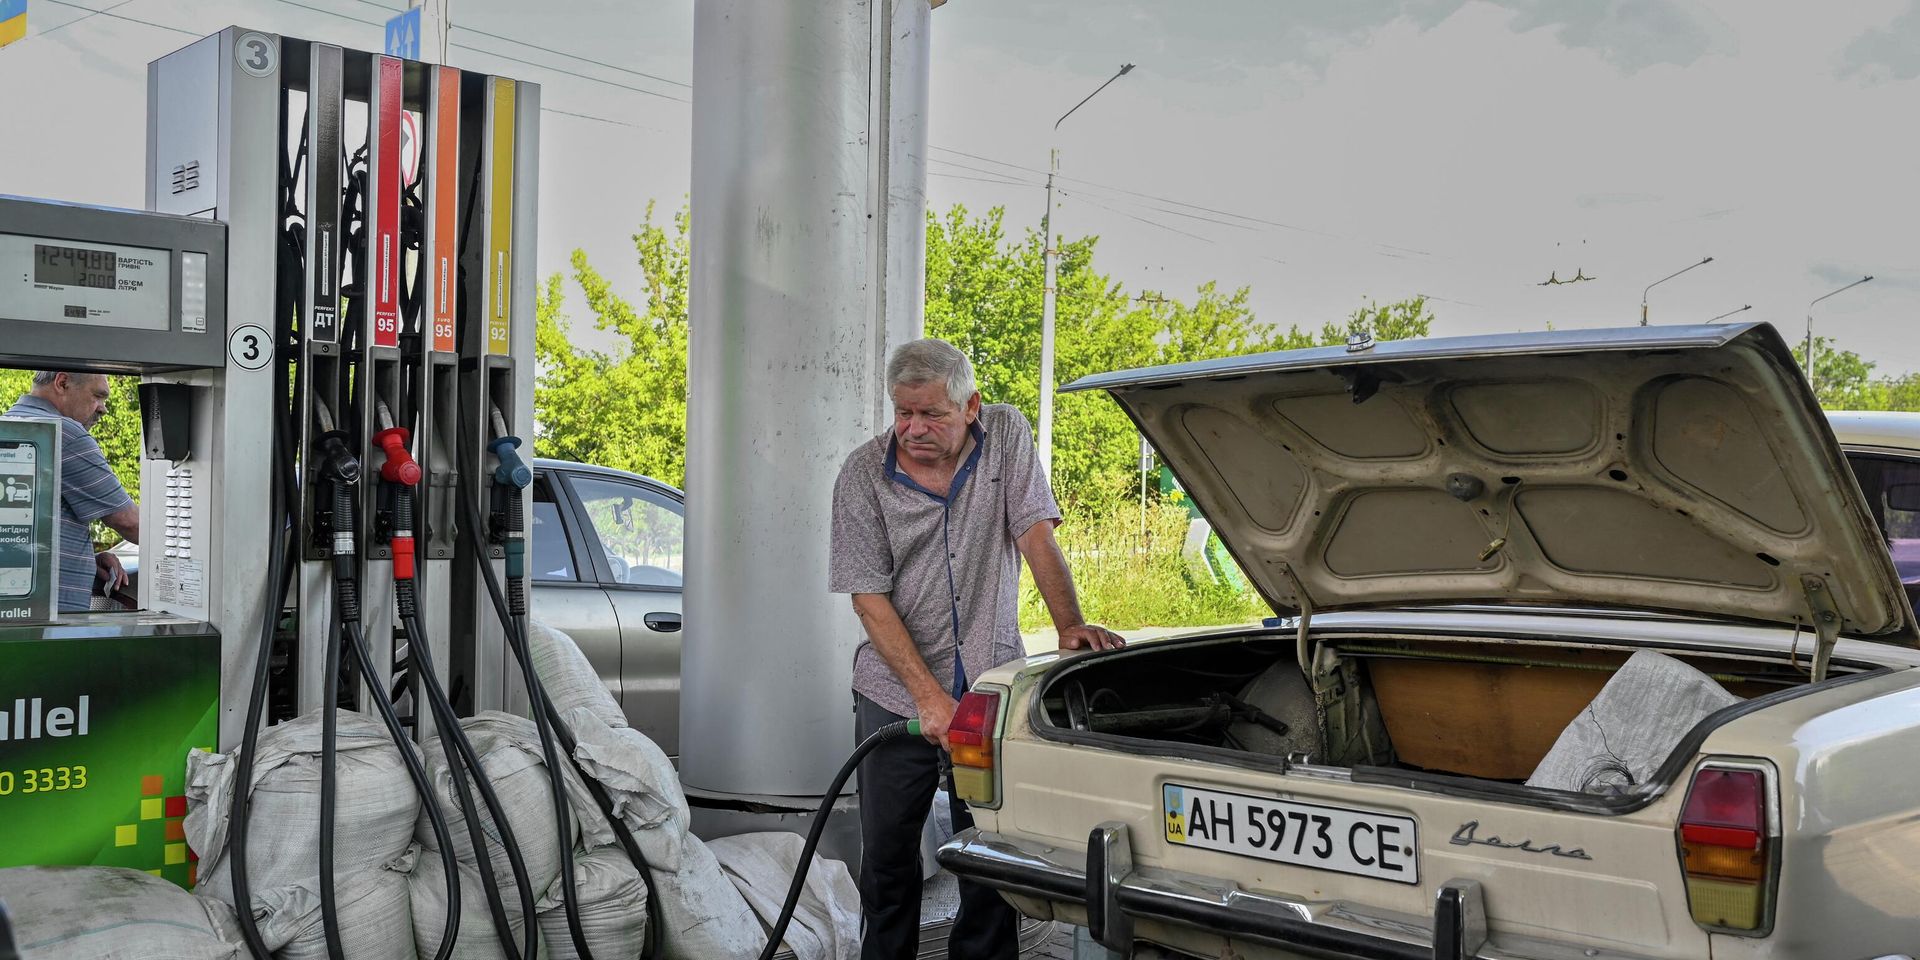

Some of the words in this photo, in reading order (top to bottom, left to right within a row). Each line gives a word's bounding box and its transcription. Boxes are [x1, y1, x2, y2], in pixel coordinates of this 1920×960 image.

[246, 40, 269, 69] 3
[315, 313, 334, 328] ДТ
[378, 318, 394, 332] 95
[435, 324, 452, 338] 95
[491, 327, 506, 341] 92
[242, 335, 259, 360] 3
[22, 765, 87, 793] 3333
[1168, 824, 1183, 836] UA
[1188, 797, 1234, 843] AH
[1247, 805, 1333, 859] 5973
[1348, 822, 1403, 871] CE
